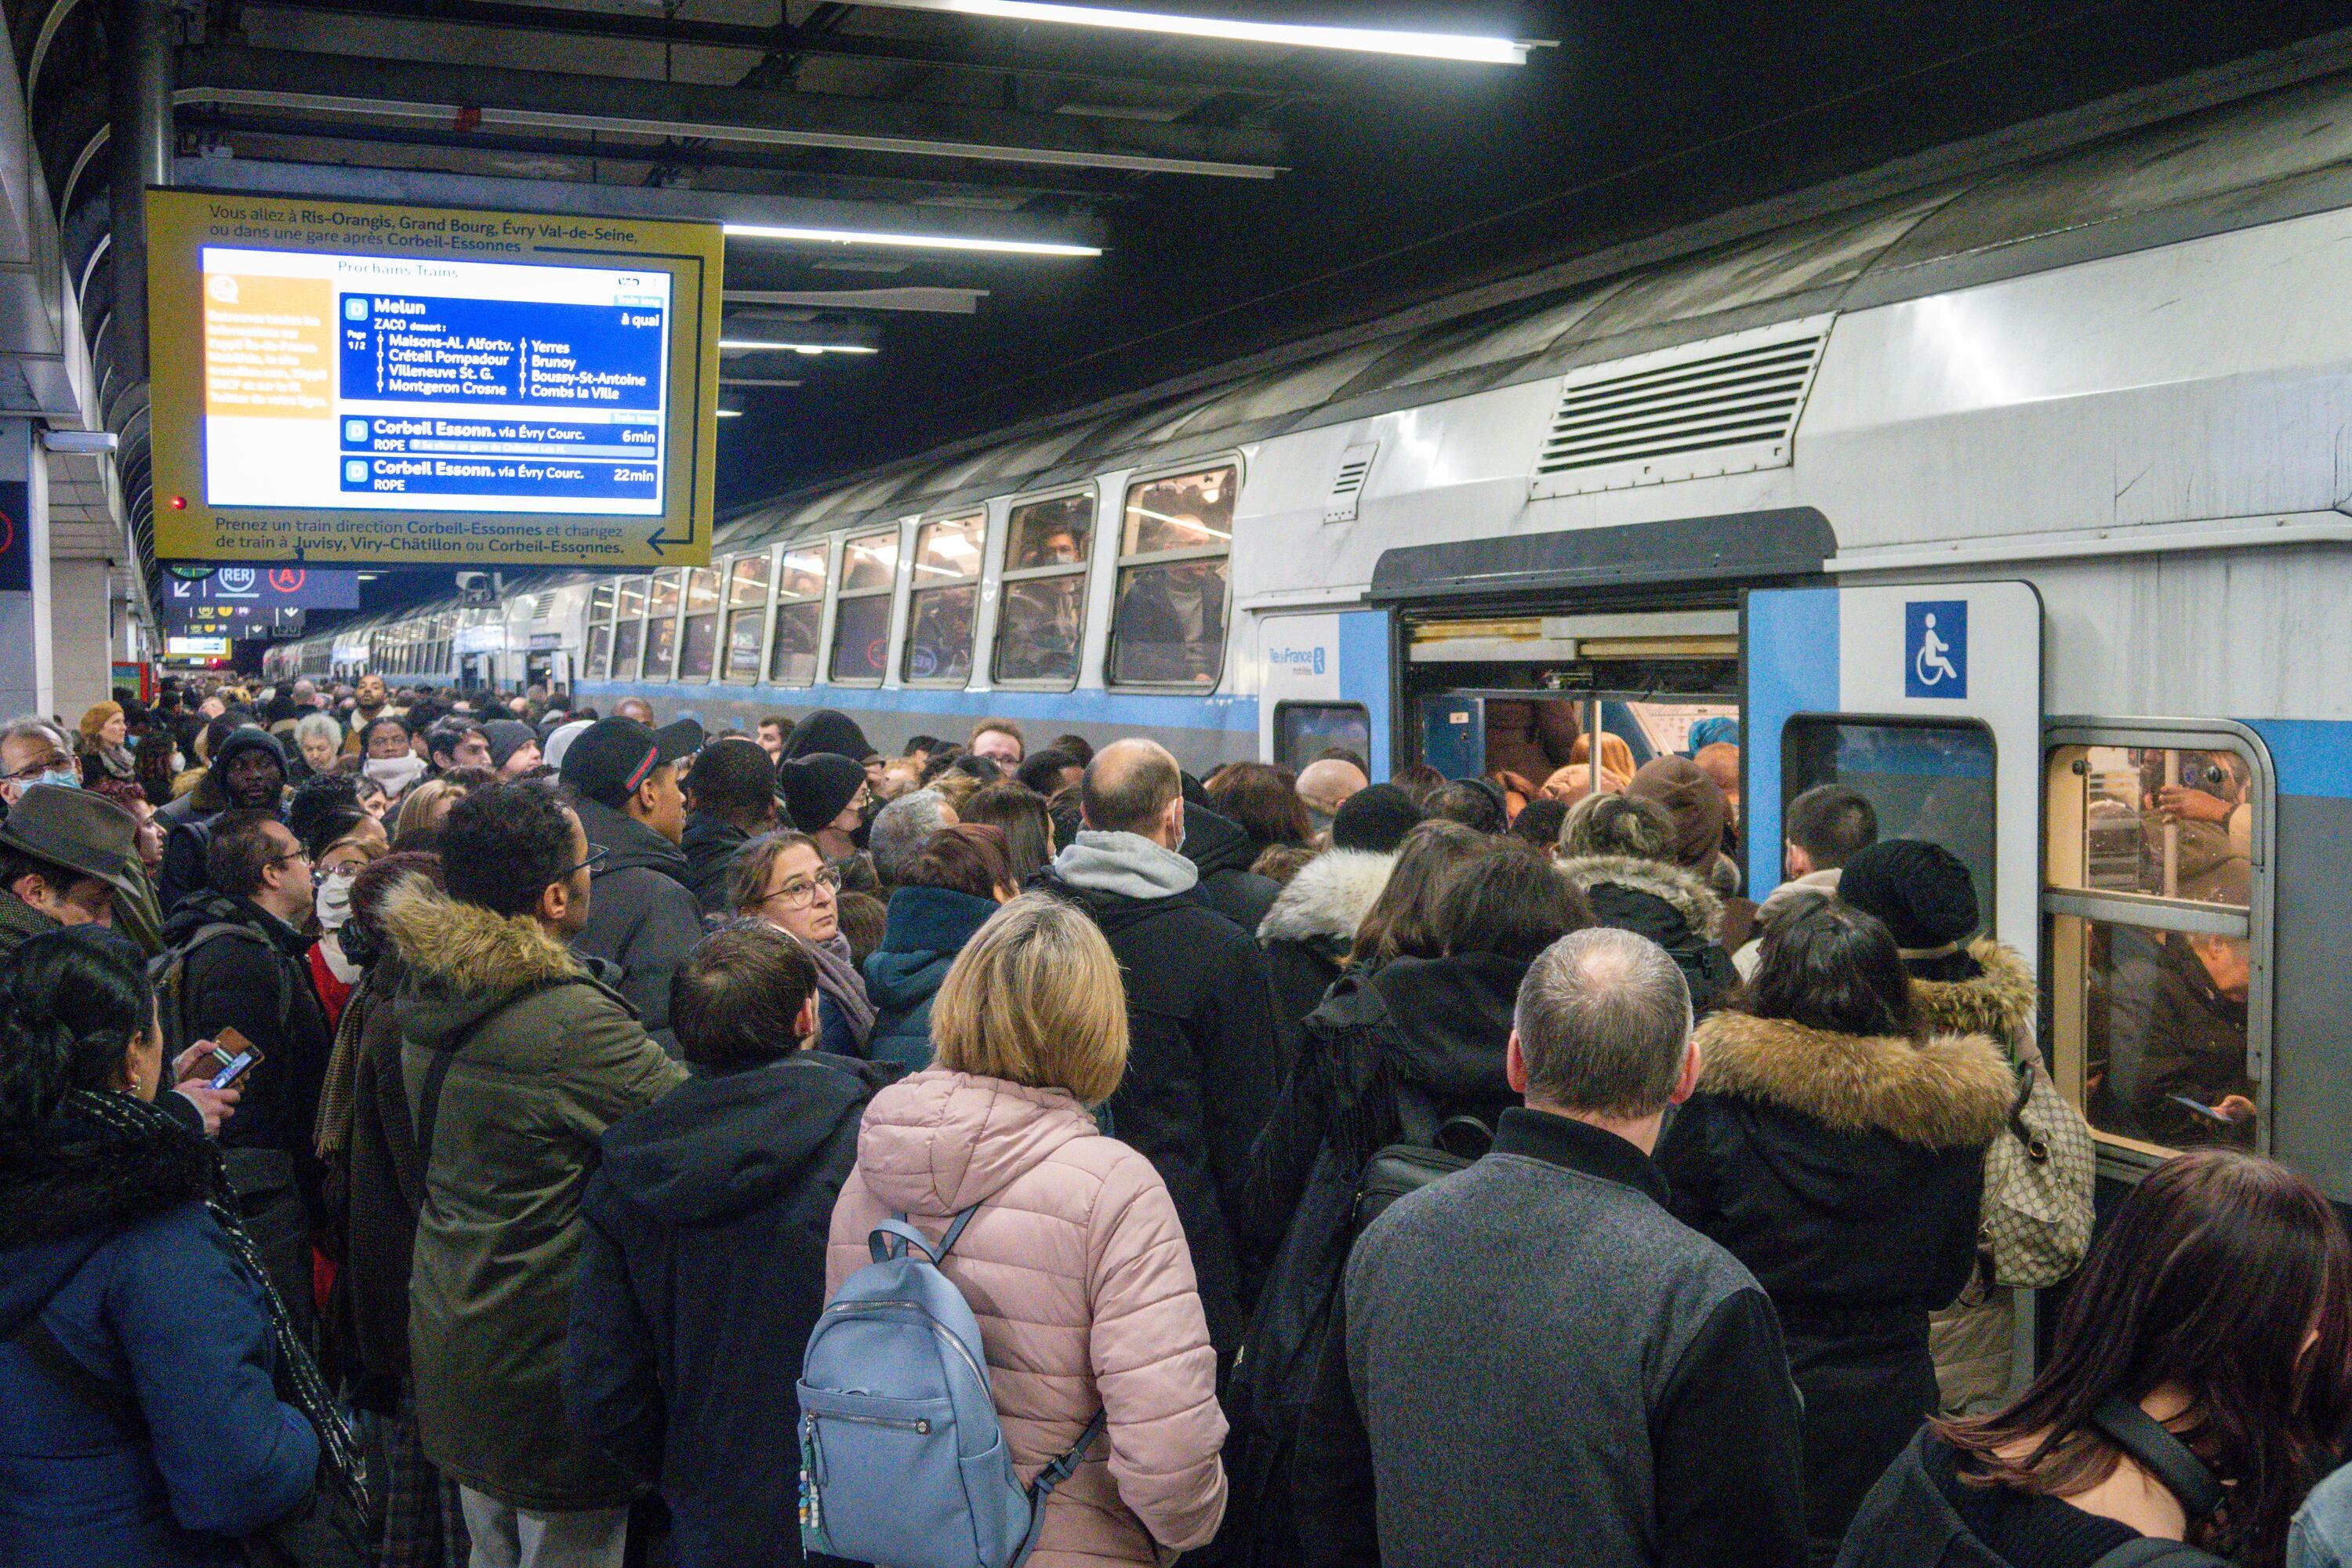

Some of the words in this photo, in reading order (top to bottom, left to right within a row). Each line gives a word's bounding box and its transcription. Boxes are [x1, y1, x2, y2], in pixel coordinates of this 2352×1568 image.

[210, 205, 246, 220] Vous
[251, 207, 284, 222] allez
[289, 209, 296, 223] à
[302, 210, 394, 230] Ris-Orangis,
[399, 216, 445, 232] Grand
[451, 220, 498, 237] Bourg,
[503, 219, 535, 238] Évry
[539, 223, 637, 244] Val-de-Seine,
[210, 225, 228, 235] ou
[234, 224, 269, 238] dans
[274, 228, 302, 241] une
[307, 230, 338, 245] gare
[343, 232, 383, 248] après
[387, 234, 521, 252] Corbeil-Essonnes
[339, 260, 411, 275] Prochains
[416, 265, 458, 278] Trains
[351, 303, 363, 316] D
[374, 298, 426, 315] Melun
[374, 318, 406, 331] ZACO
[621, 313, 630, 325] à
[632, 314, 659, 328] quai
[389, 334, 464, 350] Maisons-Al.
[466, 336, 515, 351] Alfortv.
[532, 340, 570, 354] Yerres
[389, 349, 433, 363] Créteil
[435, 350, 509, 367] Pompadour
[532, 354, 576, 371] Brunoy
[389, 364, 458, 379] Villeneuve
[459, 366, 477, 379] St.
[480, 368, 494, 379] G.
[532, 369, 647, 387] Boussy-St-Antoine
[389, 379, 460, 395] Montgeron
[463, 382, 507, 395] Crosne
[531, 384, 575, 398] Combs
[577, 386, 589, 398] la
[591, 387, 619, 399] Ville
[350, 424, 364, 437] D
[374, 419, 433, 435] Corbeil
[436, 421, 496, 437] Essonn.
[499, 426, 516, 437] via
[519, 424, 545, 441] Évry
[547, 427, 585, 441] Courc.
[622, 430, 655, 443] 6min
[374, 439, 405, 451] ROPE
[350, 465, 364, 477] D
[374, 459, 433, 475] Corbeil
[436, 461, 495, 477] Essonn.
[499, 466, 516, 477] via
[518, 464, 544, 481] Évry
[546, 466, 584, 479] Courc.
[614, 469, 655, 481] 22min
[374, 479, 405, 491] ROPE
[216, 517, 267, 532] Prenez
[272, 520, 291, 532] un
[296, 519, 331, 532] train
[336, 520, 402, 534] direction
[407, 521, 541, 536] Corbeil-Essonnes
[546, 524, 561, 536] et
[565, 524, 622, 540] changez
[216, 535, 235, 548] de
[238, 535, 274, 549] train
[279, 535, 288, 548] à
[293, 535, 347, 552] Juvisy,
[350, 536, 461, 553] Viry-Châtillon
[466, 541, 484, 552] ou
[488, 539, 624, 554] Corbeil-Essonnes.
[224, 568, 250, 581] RER
[279, 568, 296, 583] A
